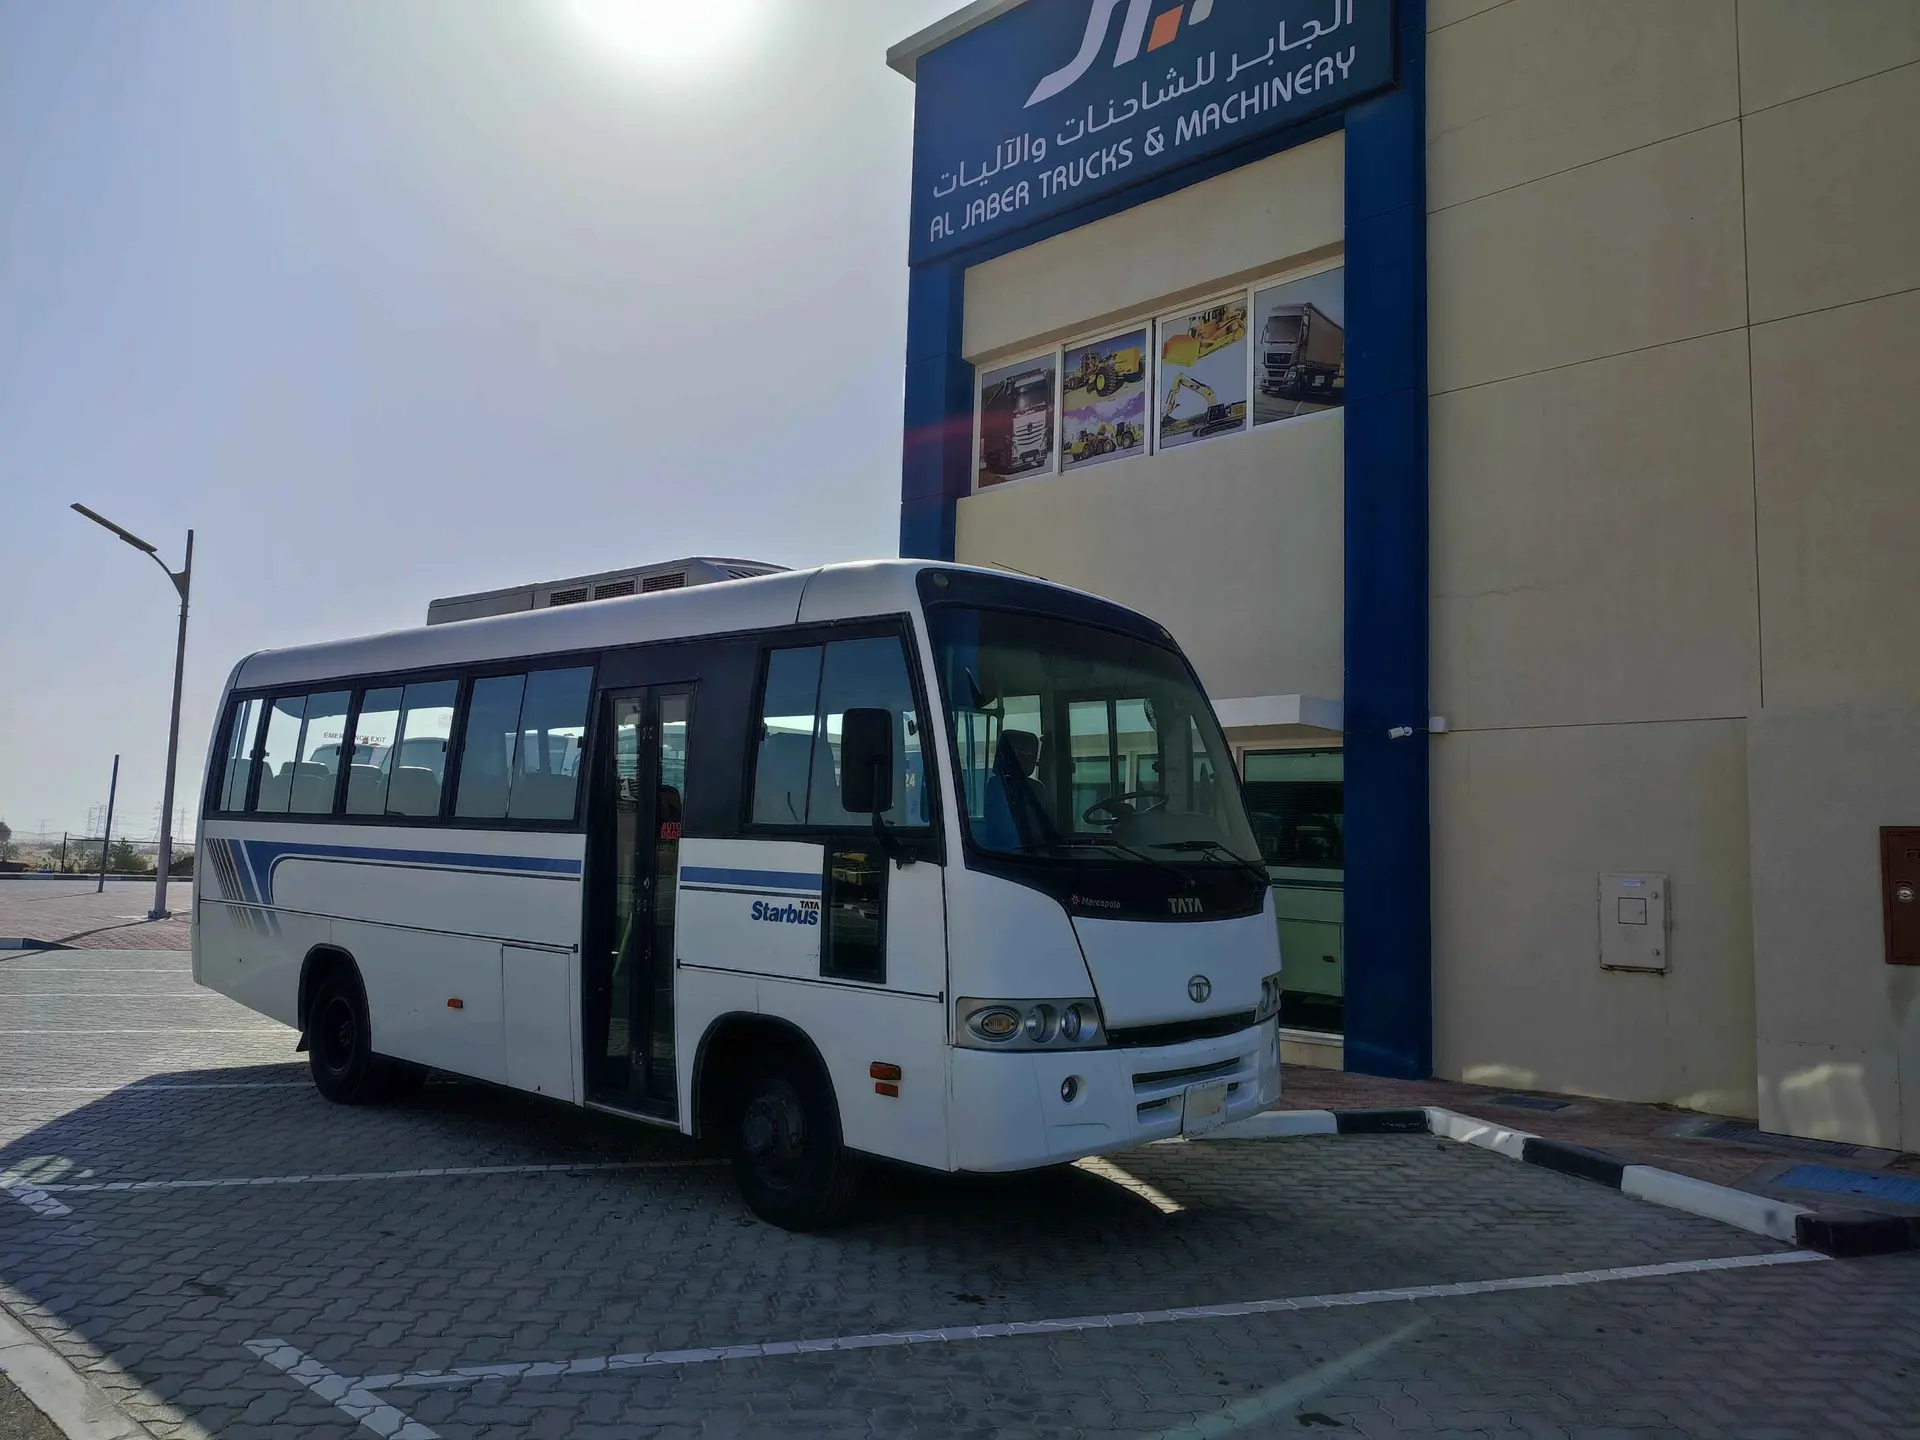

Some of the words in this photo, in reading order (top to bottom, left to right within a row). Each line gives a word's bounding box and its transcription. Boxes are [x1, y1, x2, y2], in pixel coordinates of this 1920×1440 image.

[1226, 0, 1353, 83] الجابر
[1056, 50, 1216, 146] للشاحنات
[929, 211, 955, 242] AL
[961, 180, 1029, 230] JABER
[1038, 137, 1134, 199] TRUCKS
[1143, 125, 1165, 156] &
[1174, 45, 1356, 146] MACHINERY
[933, 132, 1047, 198] والآليات
[370, 735, 386, 743] EXIT
[750, 900, 818, 925] Starbus
[800, 900, 820, 909] TATA
[1081, 897, 1121, 909] Marcopolo
[1168, 897, 1204, 913] TATA
